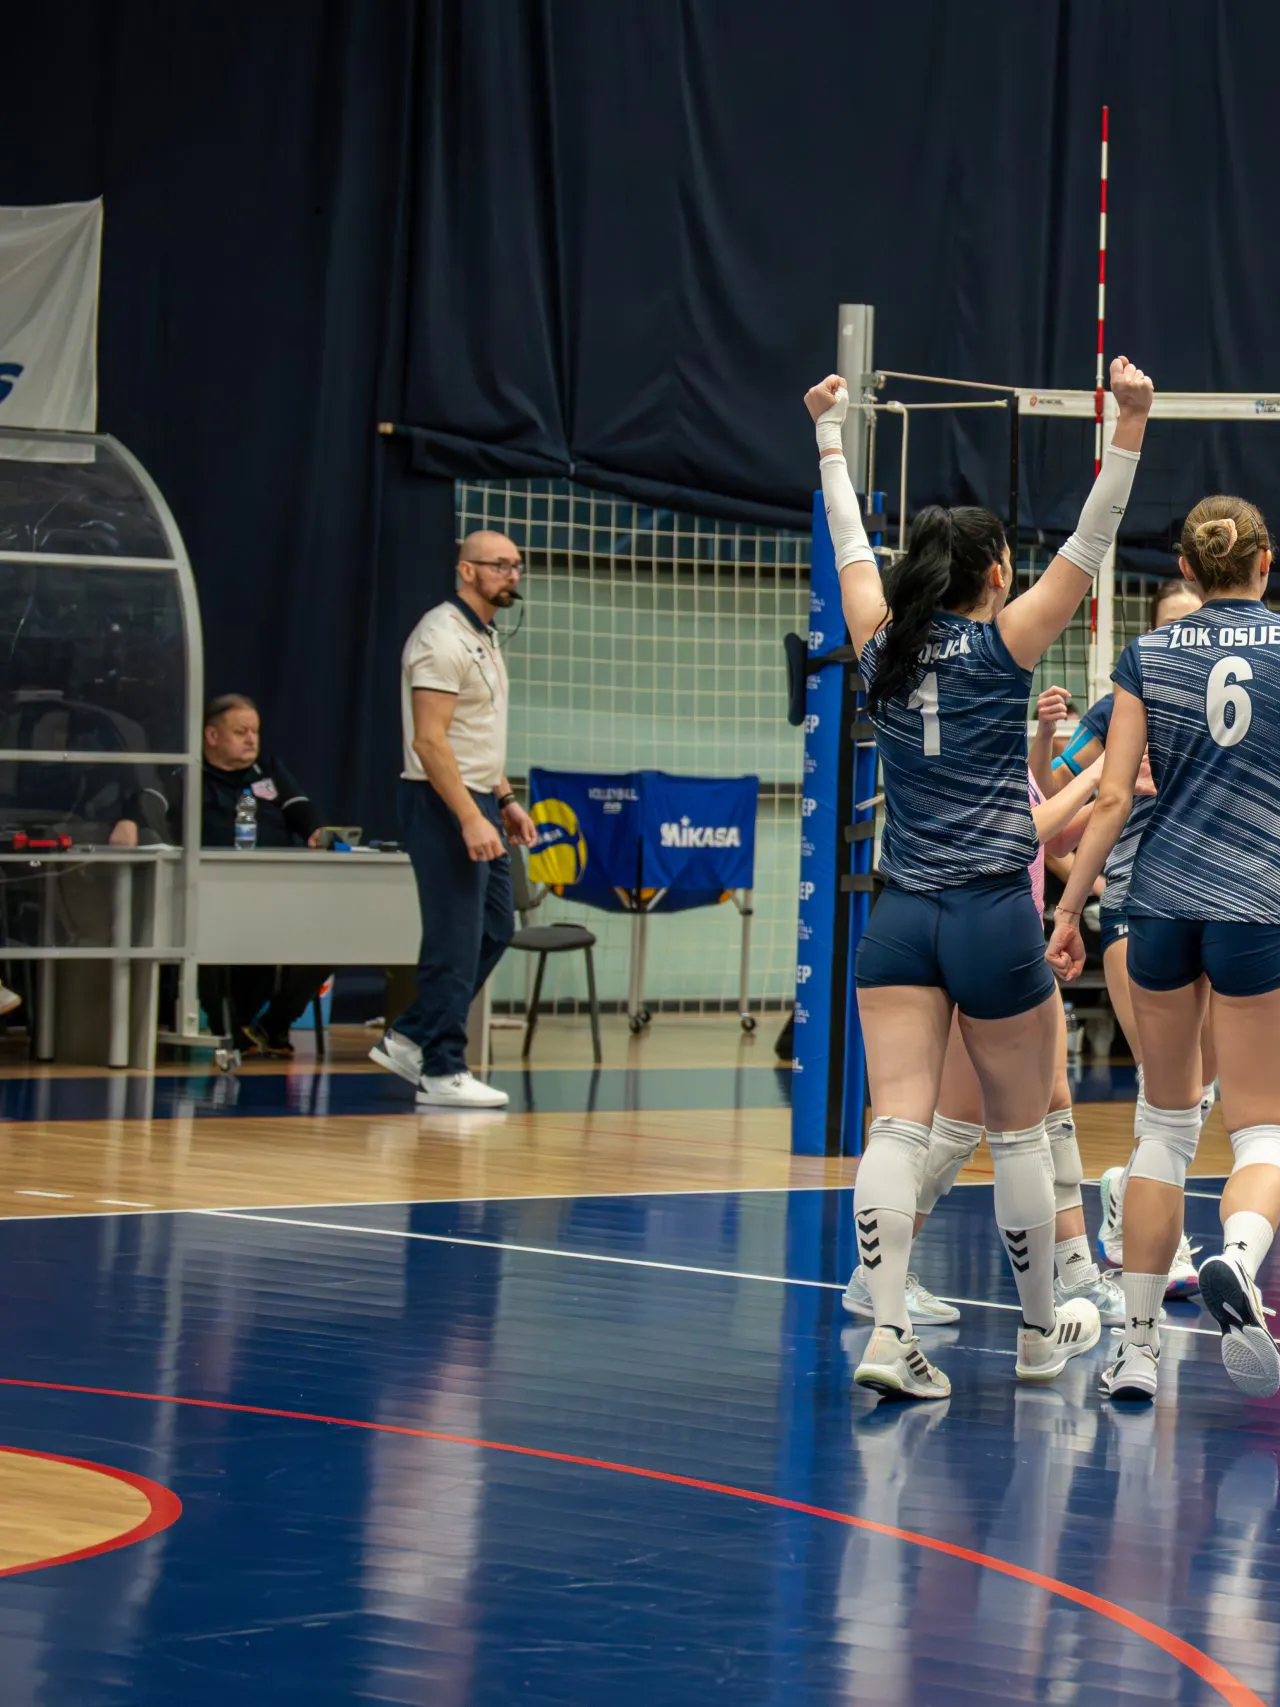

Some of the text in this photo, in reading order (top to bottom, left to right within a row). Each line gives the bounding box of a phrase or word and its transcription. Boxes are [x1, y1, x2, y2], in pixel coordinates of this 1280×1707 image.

[1169, 624, 1212, 649] ŽOK
[906, 671, 940, 756] 1
[1206, 655, 1253, 747] 6
